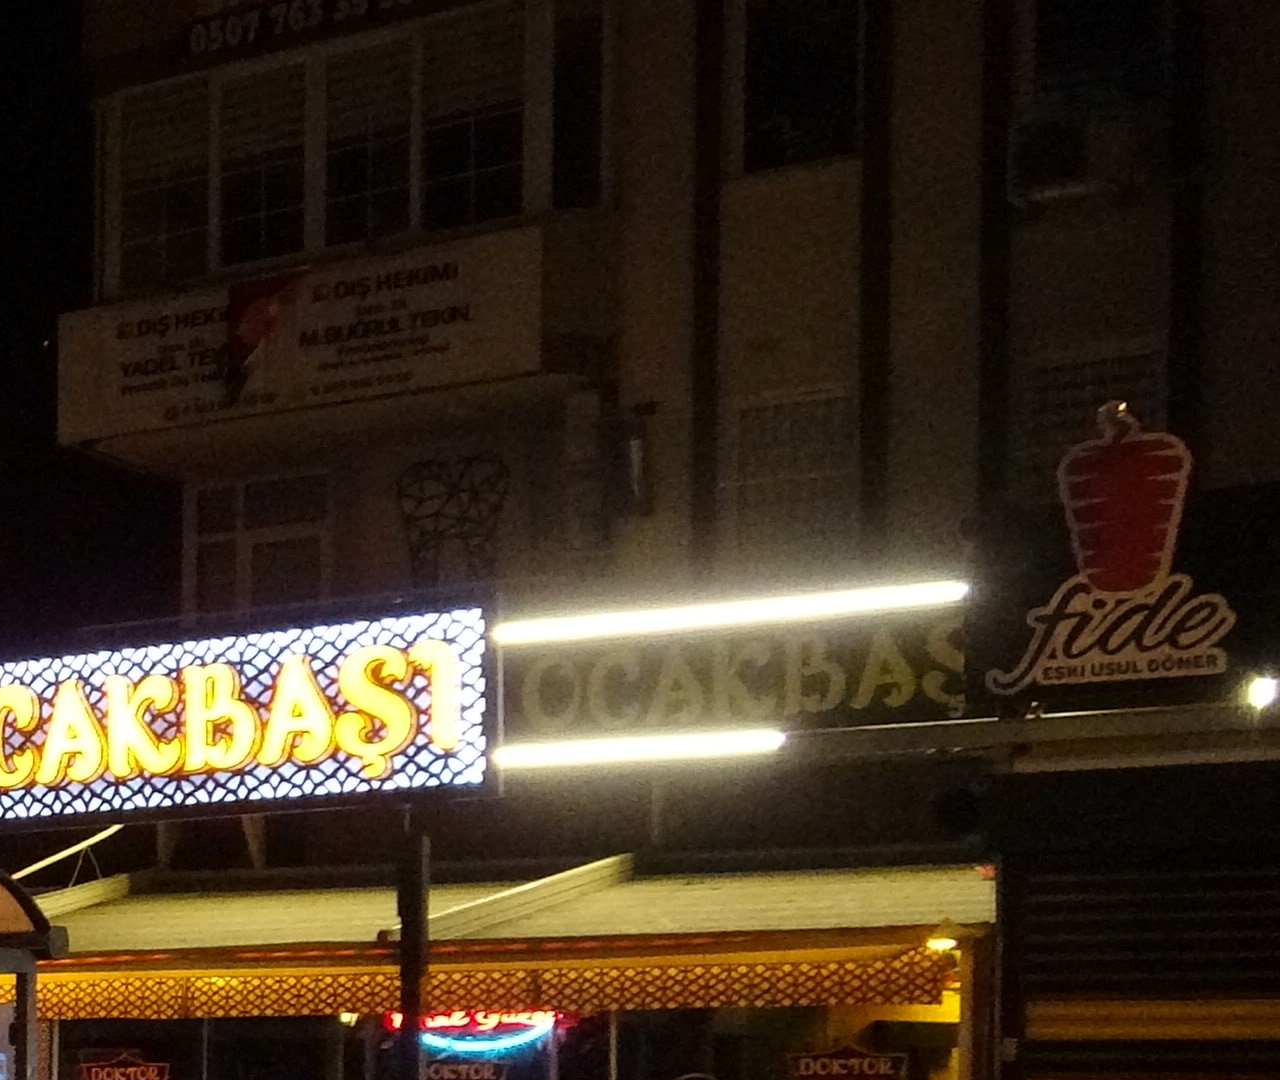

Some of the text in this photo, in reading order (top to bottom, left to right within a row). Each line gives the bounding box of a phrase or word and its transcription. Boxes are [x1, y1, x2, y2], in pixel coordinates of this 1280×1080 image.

[522, 613, 966, 727] OCAKBAŞ
[1091, 659, 1143, 678] USUL
[426, 1062, 496, 1080] OKTOR
[798, 1056, 895, 1076] DOKTOR
